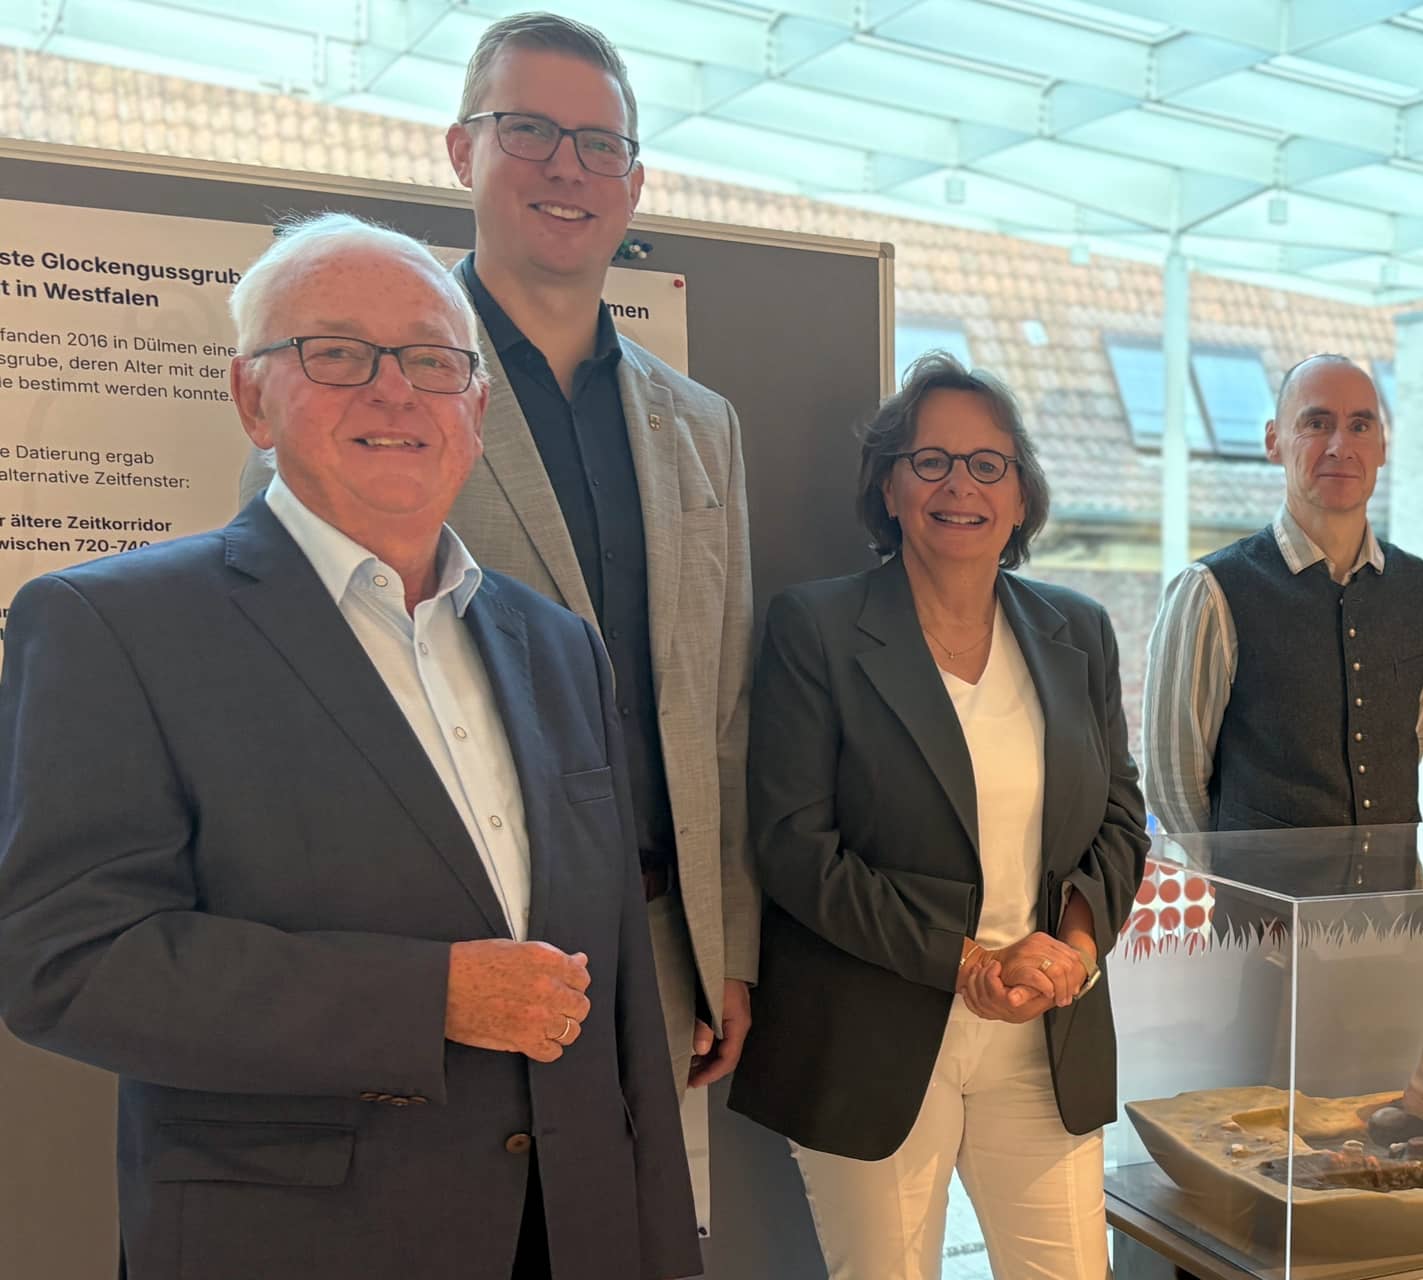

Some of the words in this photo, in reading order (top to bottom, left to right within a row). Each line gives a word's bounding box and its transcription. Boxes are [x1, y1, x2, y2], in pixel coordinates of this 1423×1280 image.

[0, 250, 35, 268] ste
[41, 252, 241, 286] Glockengussgrub
[16, 279, 37, 298] in
[43, 282, 159, 308] Westfalen
[0, 328, 61, 345] fanden
[67, 332, 108, 349] 2016
[113, 335, 128, 350] in
[133, 337, 198, 355] Dülmen
[202, 342, 237, 357] eine
[69, 356, 118, 372] deren
[124, 359, 164, 375] Alter
[168, 363, 194, 377] mit
[199, 365, 226, 379] der
[19, 376, 100, 394] bestimmt
[105, 383, 168, 398] werden
[173, 385, 234, 402] konnte.
[16, 445, 100, 465] Datierung
[106, 451, 154, 467] ergab
[0, 468, 89, 485] alternative
[95, 471, 190, 489] Zeitfenster:
[11, 513, 62, 529] ältere
[67, 515, 172, 532] Zeitkorridor
